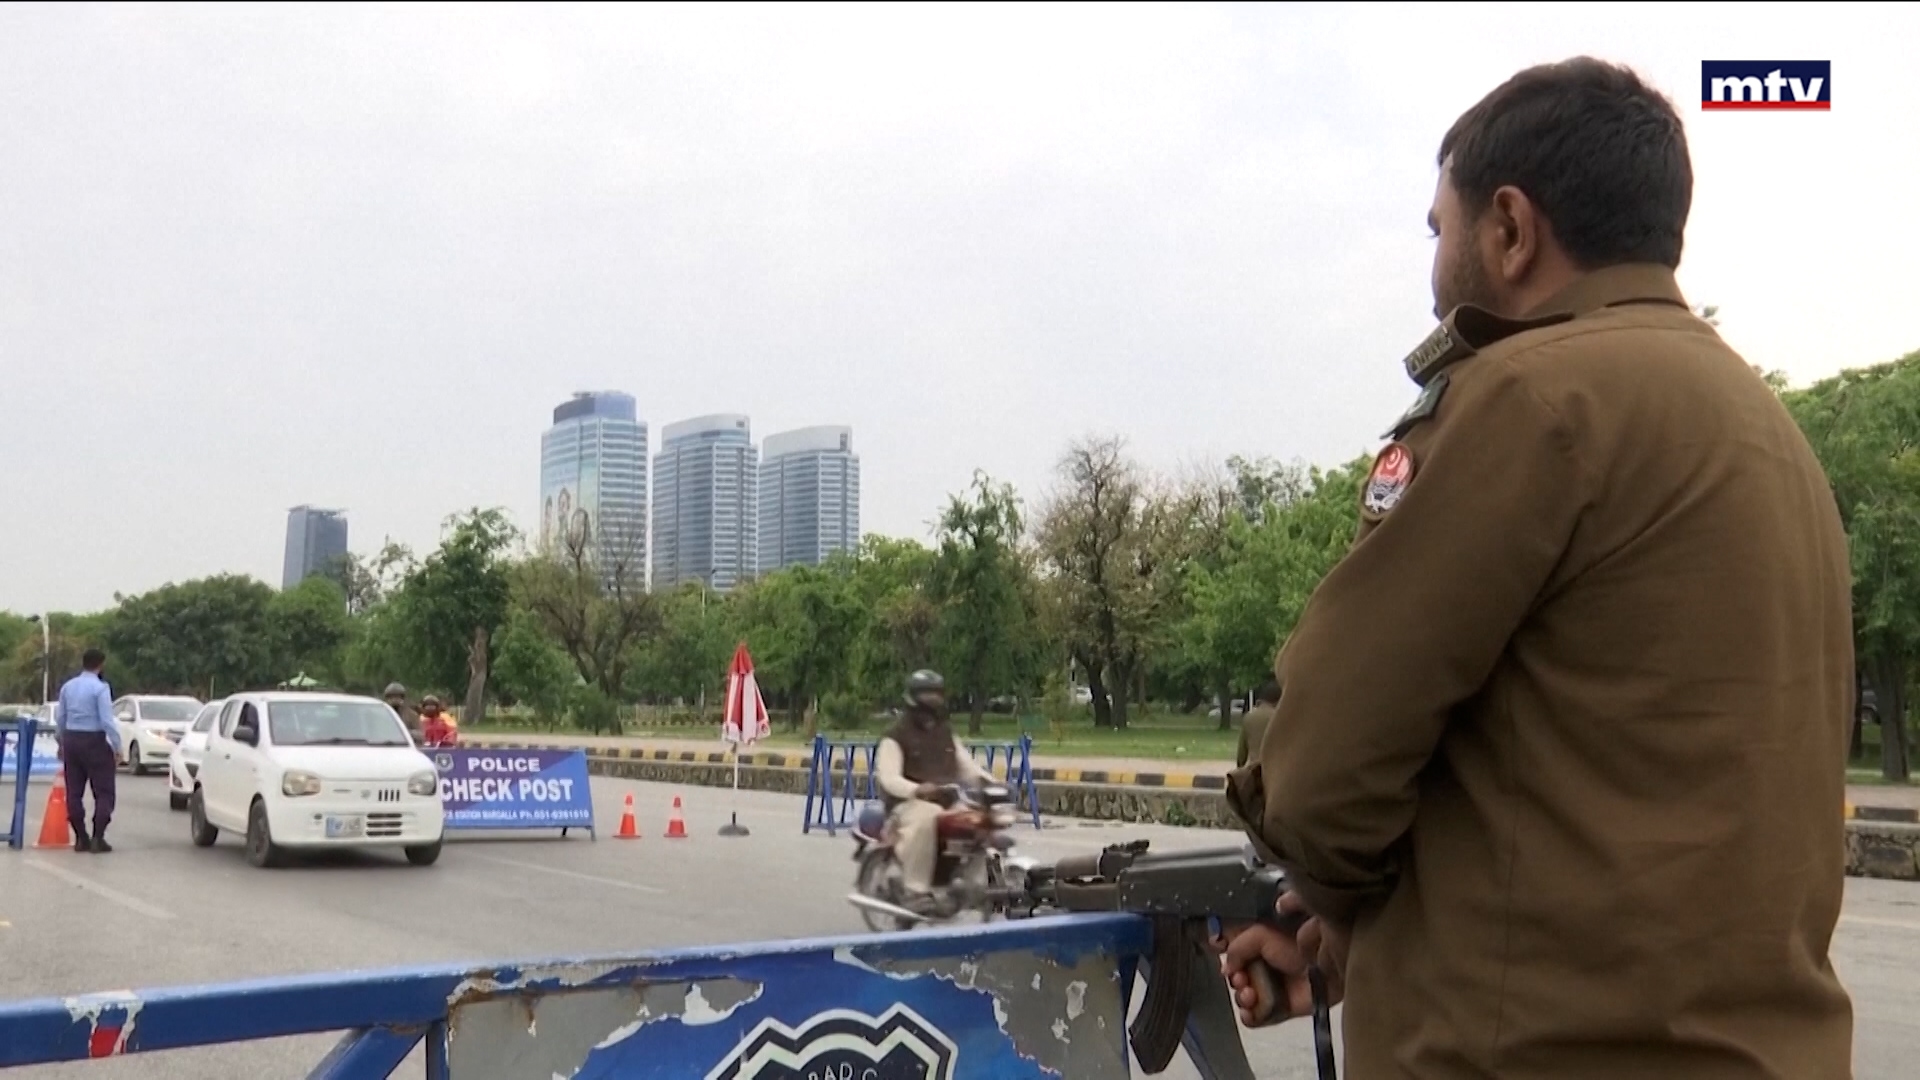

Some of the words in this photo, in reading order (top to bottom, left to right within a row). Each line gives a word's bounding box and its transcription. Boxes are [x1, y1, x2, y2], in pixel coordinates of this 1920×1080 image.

[467, 757, 541, 772] POLICE
[440, 778, 514, 802] CHECK
[519, 778, 573, 802] POST
